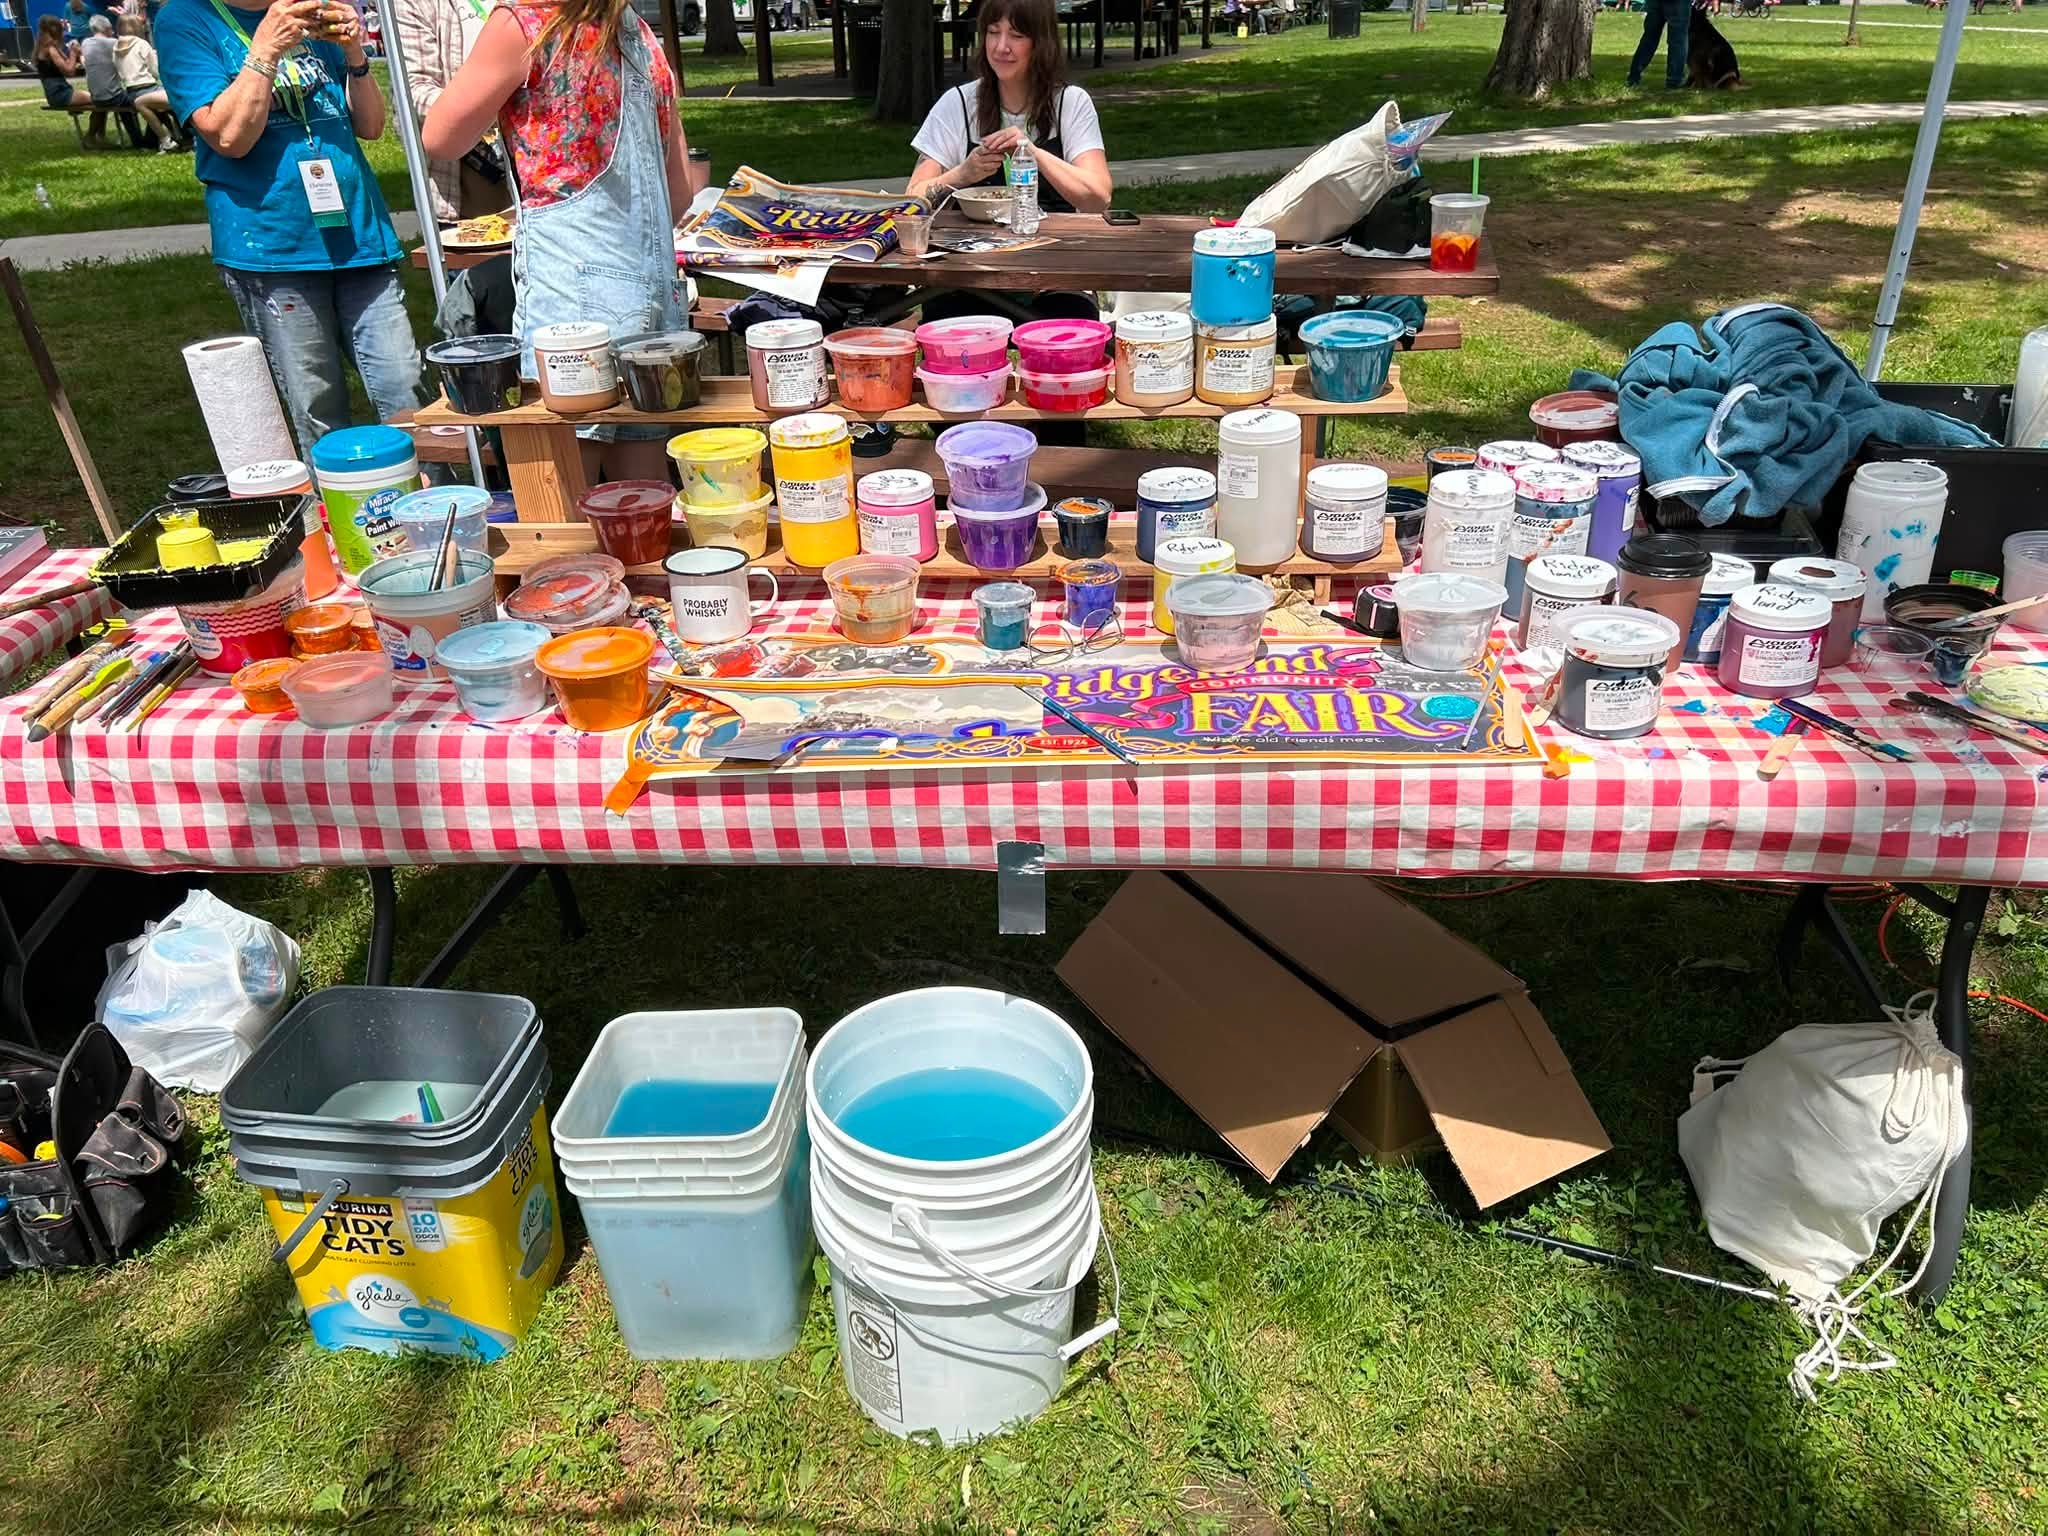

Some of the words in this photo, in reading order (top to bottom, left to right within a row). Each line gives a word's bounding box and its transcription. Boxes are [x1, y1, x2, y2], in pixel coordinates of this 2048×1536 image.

[374, 504, 393, 516] Bran
[367, 522, 388, 536] Paint
[683, 598, 729, 609] PROBABLY
[1758, 586, 1816, 607] Ridge
[685, 607, 728, 617] WHISKEY
[1190, 675, 1360, 690] COMMUNITY
[1189, 690, 1469, 737] FAIR
[1255, 735, 1279, 743] old
[330, 1201, 389, 1215] PURINA
[321, 1215, 394, 1237] TIDY
[410, 1213, 437, 1226] 10
[321, 1234, 406, 1257] CATS
[356, 1286, 412, 1310] glade
